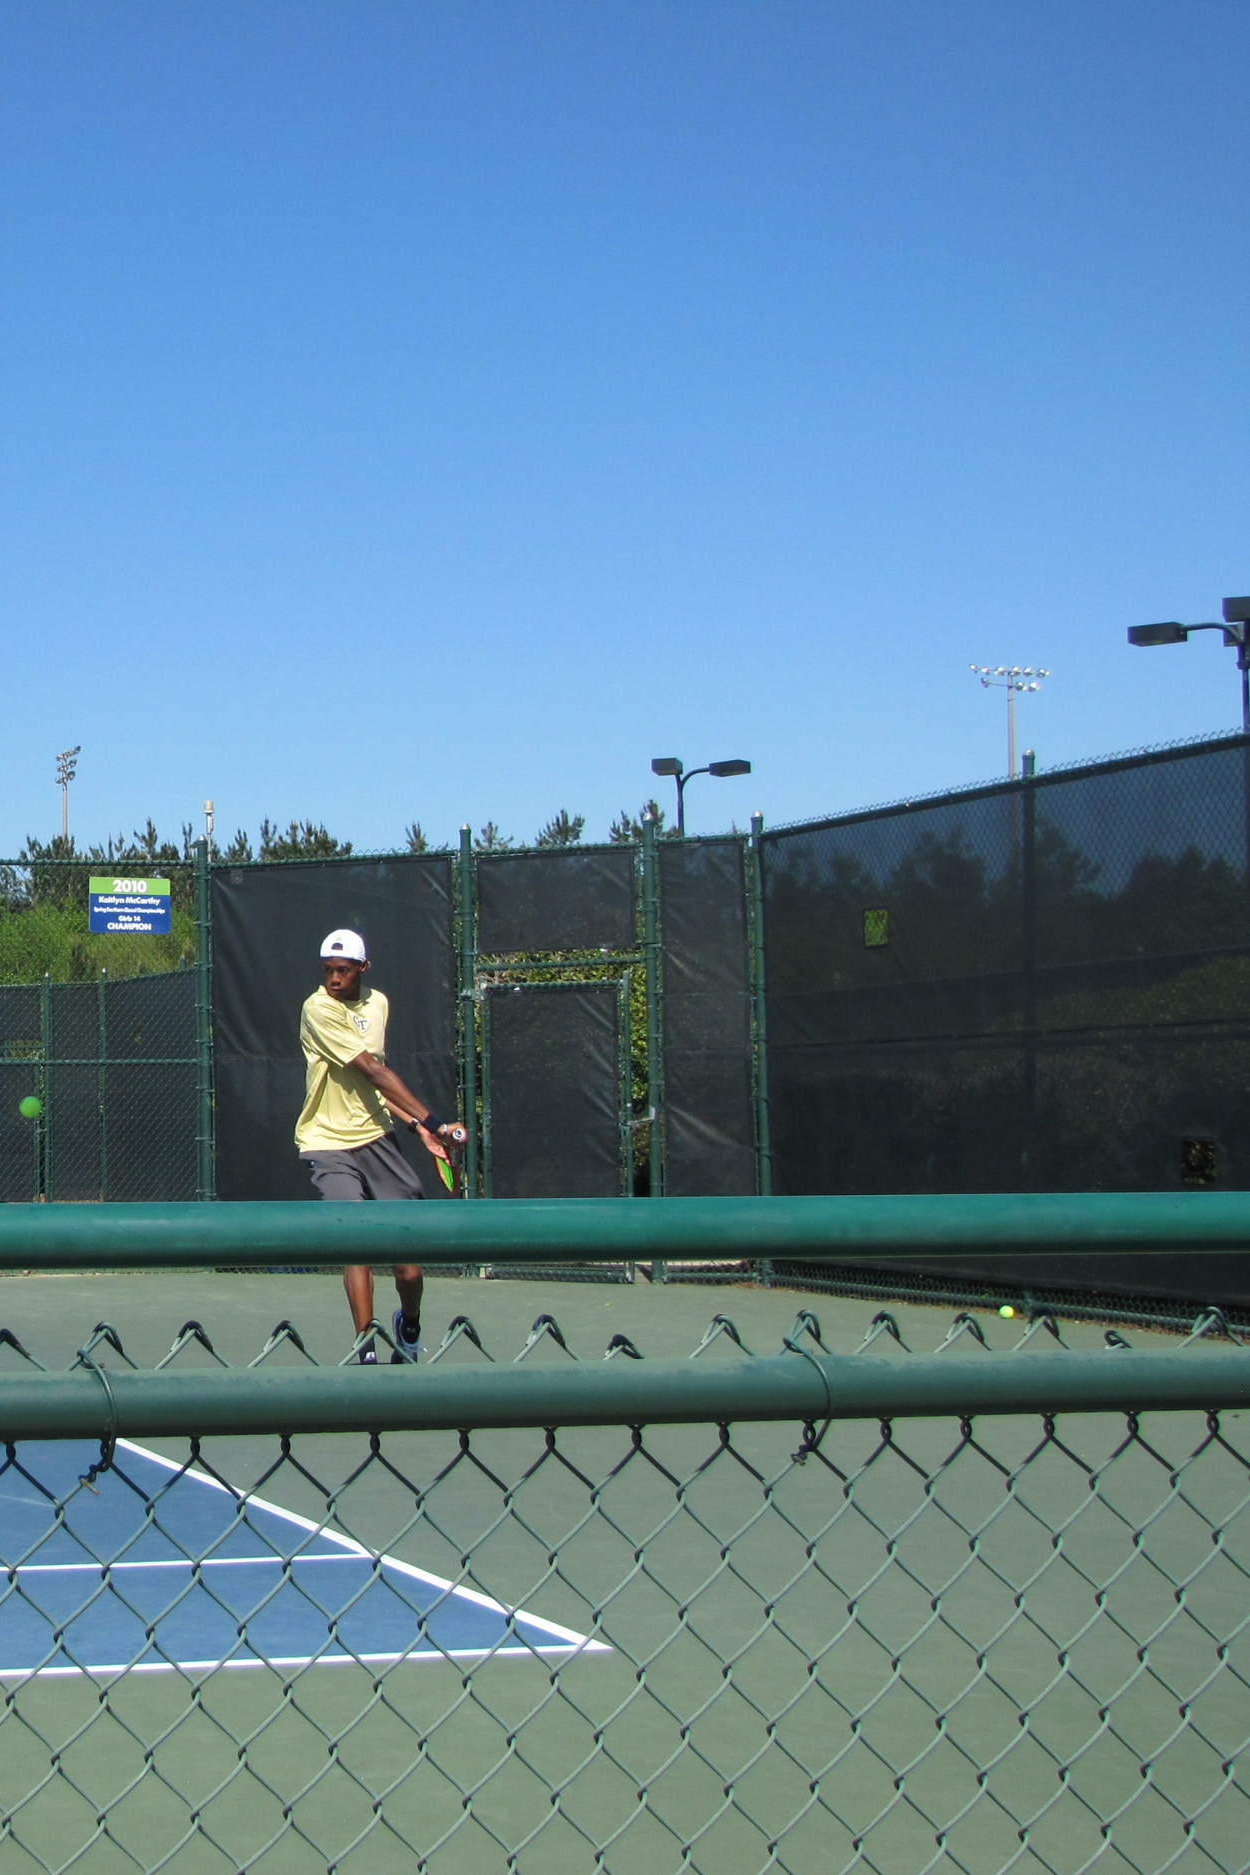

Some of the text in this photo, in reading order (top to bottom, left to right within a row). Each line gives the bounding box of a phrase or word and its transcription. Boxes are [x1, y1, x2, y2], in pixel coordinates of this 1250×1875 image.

[112, 879, 148, 894] 2010
[98, 895, 161, 906] Kaitlyn McCarthy
[107, 922, 152, 931] CHAMPION
